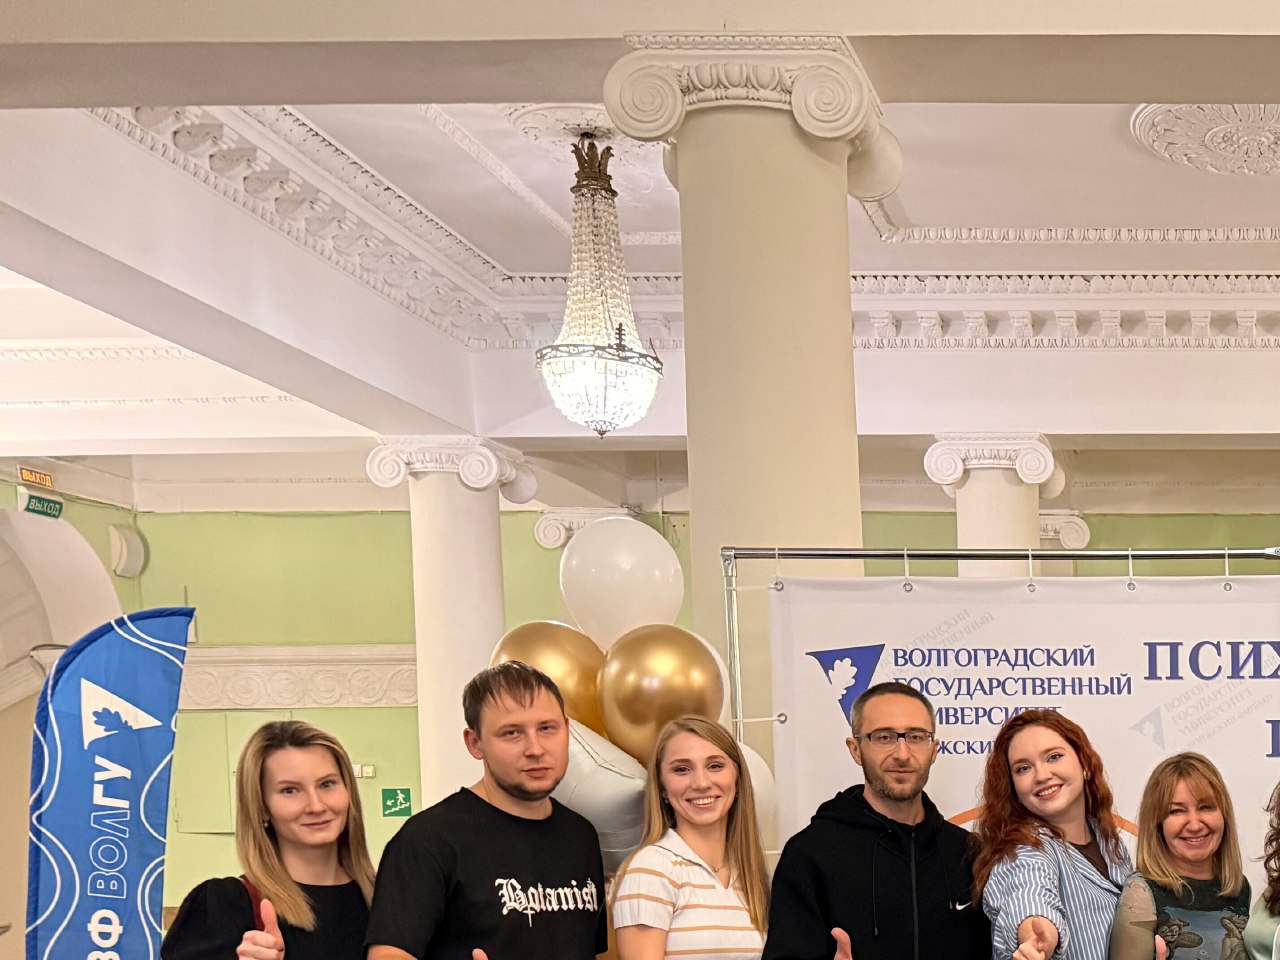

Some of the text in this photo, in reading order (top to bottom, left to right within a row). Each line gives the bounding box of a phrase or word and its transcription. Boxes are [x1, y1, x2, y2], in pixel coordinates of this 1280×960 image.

[21, 469, 53, 487] ВЫХОД
[28, 498, 61, 516] ВЫХОД
[892, 644, 1095, 671] ВОЛГОГРАДСКИЙ
[87, 755, 132, 899] ВОЛГУ
[494, 877, 598, 928] Botanist
